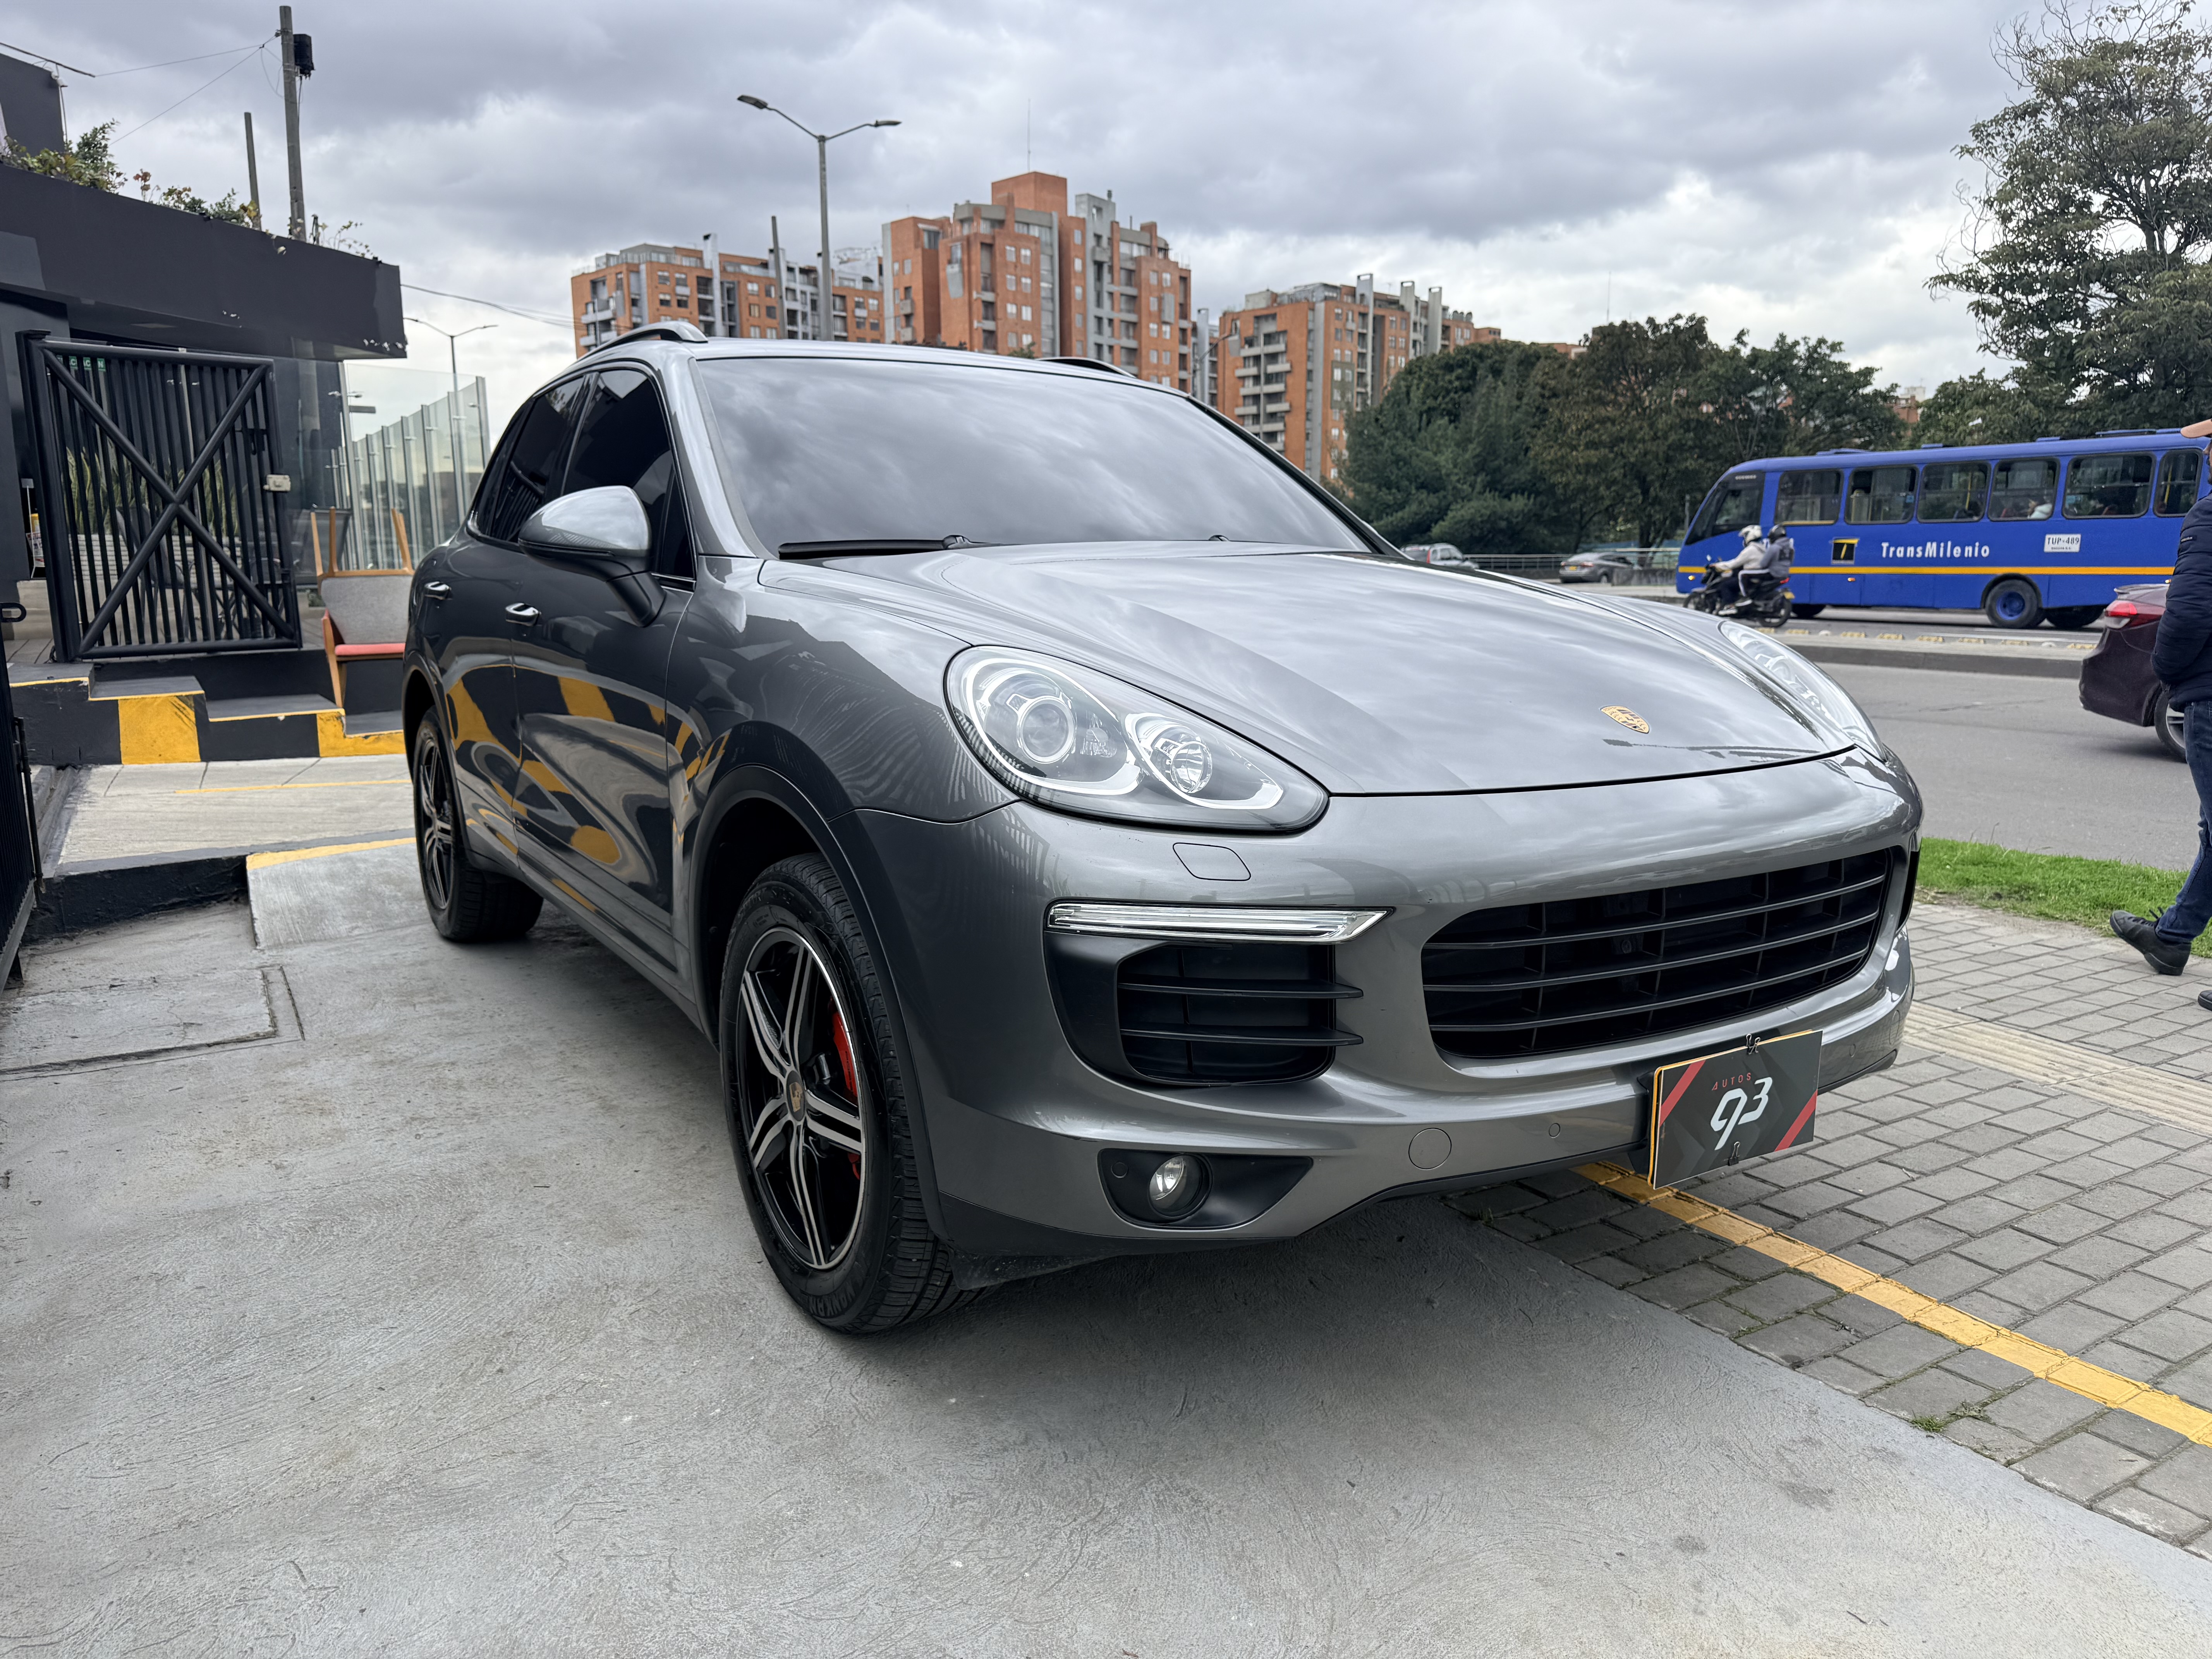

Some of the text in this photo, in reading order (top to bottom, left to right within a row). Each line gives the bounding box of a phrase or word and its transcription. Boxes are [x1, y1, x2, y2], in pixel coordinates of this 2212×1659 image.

[1881, 540, 1990, 558] TransMilenio
[1711, 1072, 1752, 1091] AUTOS
[1710, 1077, 1773, 1151] 93
[801, 1280, 856, 1317] NANKAN
